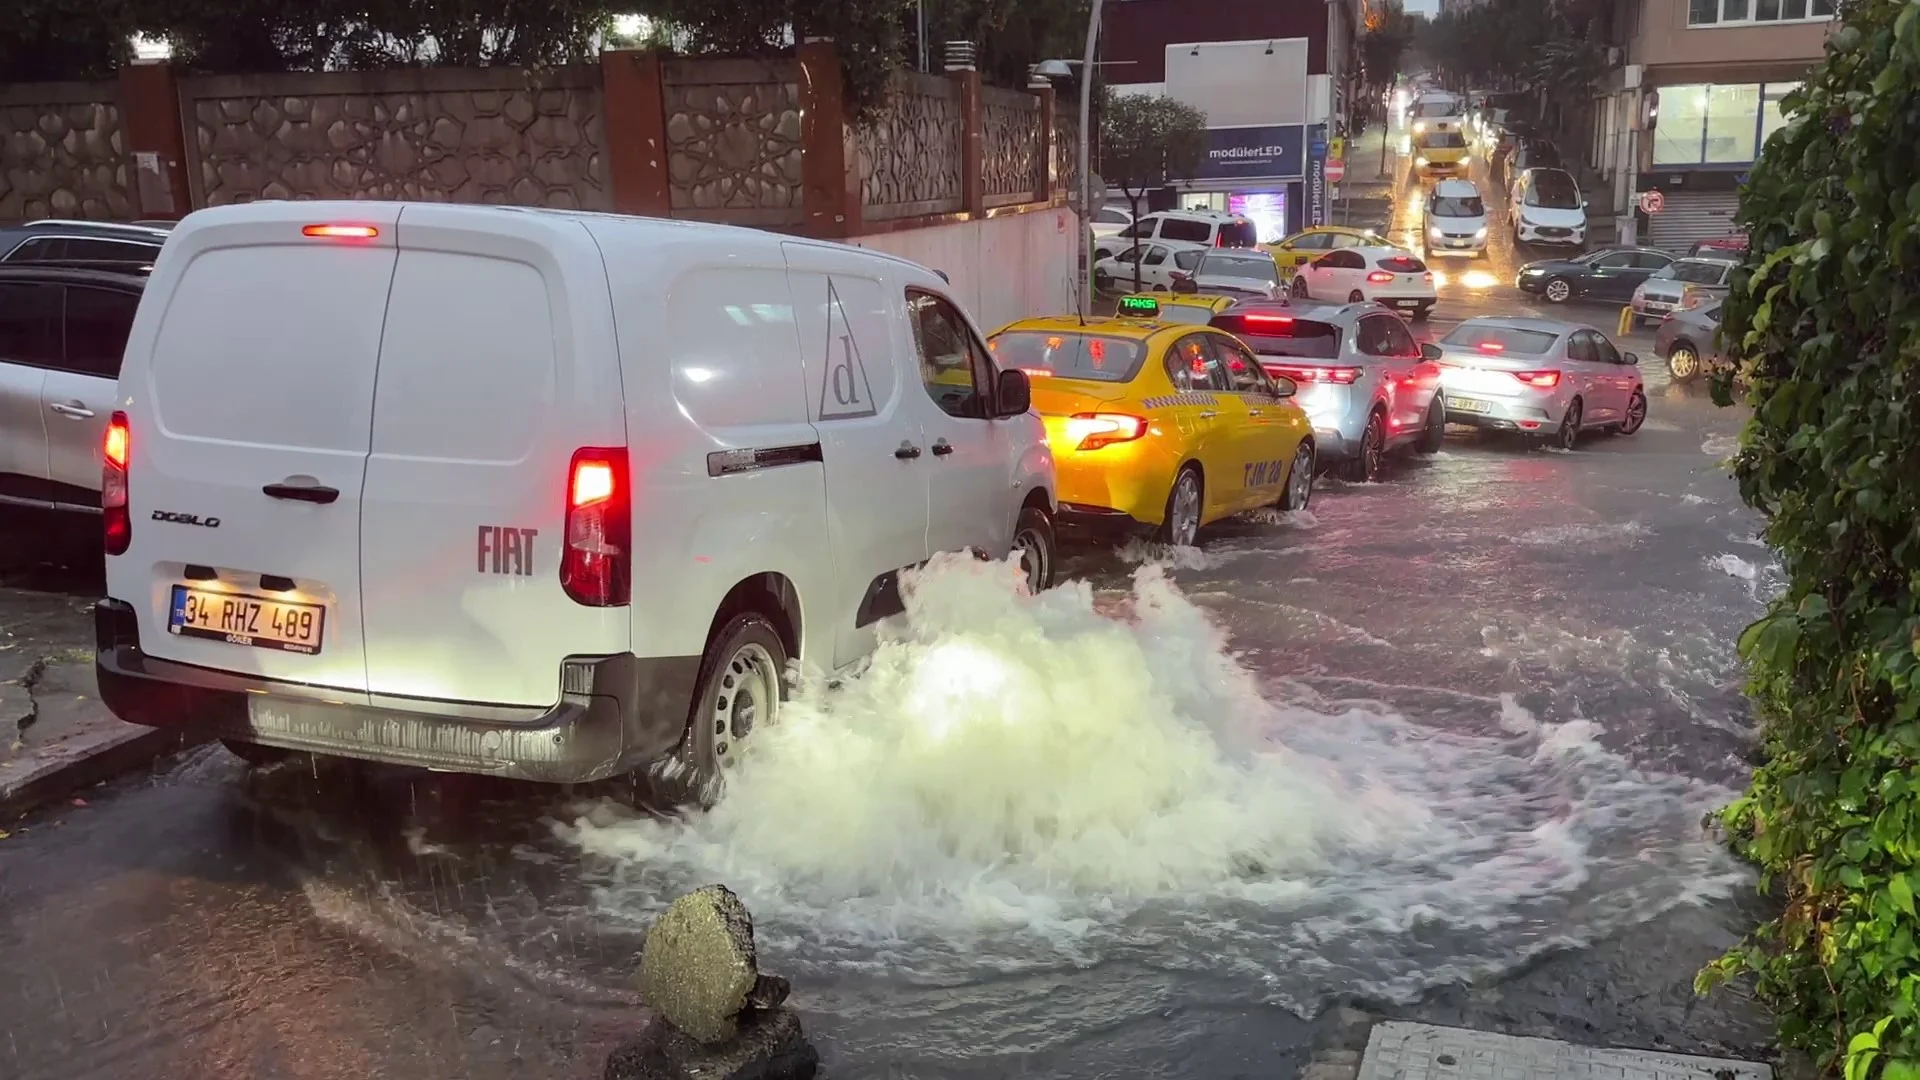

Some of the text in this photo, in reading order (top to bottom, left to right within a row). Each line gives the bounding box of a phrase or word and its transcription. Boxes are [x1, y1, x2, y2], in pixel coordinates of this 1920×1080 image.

[1209, 145, 1283, 158] modülerLED
[1244, 459, 1283, 488] TJM 28
[151, 510, 221, 528] DOBLO
[478, 525, 538, 576] FIAT
[185, 595, 313, 640] 34 RHZ 489
